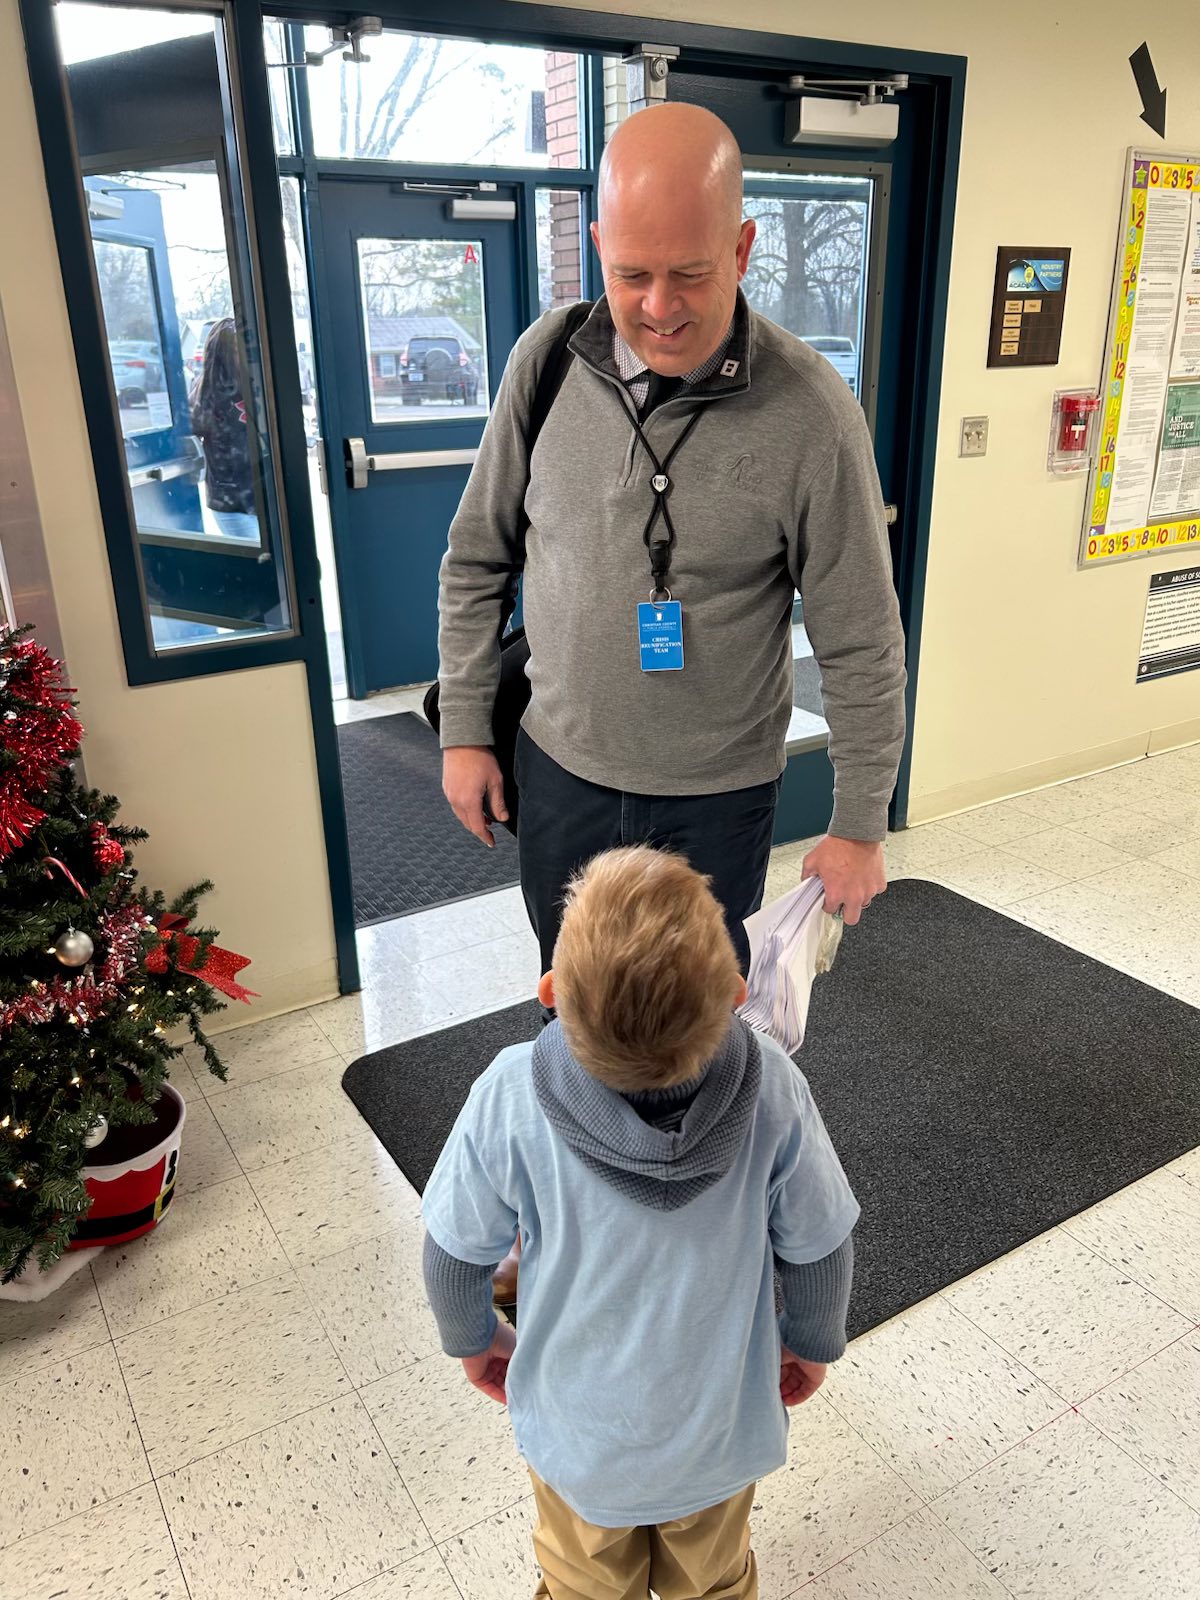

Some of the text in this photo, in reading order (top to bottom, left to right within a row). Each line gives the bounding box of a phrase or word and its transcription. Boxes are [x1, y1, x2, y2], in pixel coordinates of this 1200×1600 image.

[1150, 165, 1160, 185] 0
[1164, 166, 1172, 185] 2
[1171, 169, 1179, 188] 3
[1179, 167, 1187, 187] 4
[1186, 170, 1194, 190] 5
[1135, 210, 1145, 229] 2
[464, 243, 477, 264] A
[1129, 265, 1137, 283] 6
[1123, 279, 1130, 297] 7
[1126, 289, 1135, 308] 8
[1120, 306, 1127, 322] 9
[1115, 342, 1124, 361] 11
[1114, 361, 1125, 379] 12
[1109, 398, 1120, 416] 14
[1169, 422, 1194, 431] JUSTICE
[1175, 431, 1187, 439] ALL
[1105, 436, 1115, 453] 16
[1099, 454, 1110, 472] 17
[1088, 539, 1097, 556] 0
[1101, 537, 1108, 552] 2
[1108, 538, 1115, 554] 3
[1116, 535, 1122, 551] 4
[1122, 535, 1129, 552] 5
[1130, 532, 1136, 548] 6
[1136, 534, 1142, 549] 7
[1141, 530, 1149, 545] 8
[1149, 532, 1156, 546] 9
[1156, 528, 1168, 544] 10
[1177, 525, 1187, 541] 12
[1187, 524, 1197, 541] 13
[1171, 573, 1188, 583] ABUSE
[1188, 572, 1195, 580] OF
